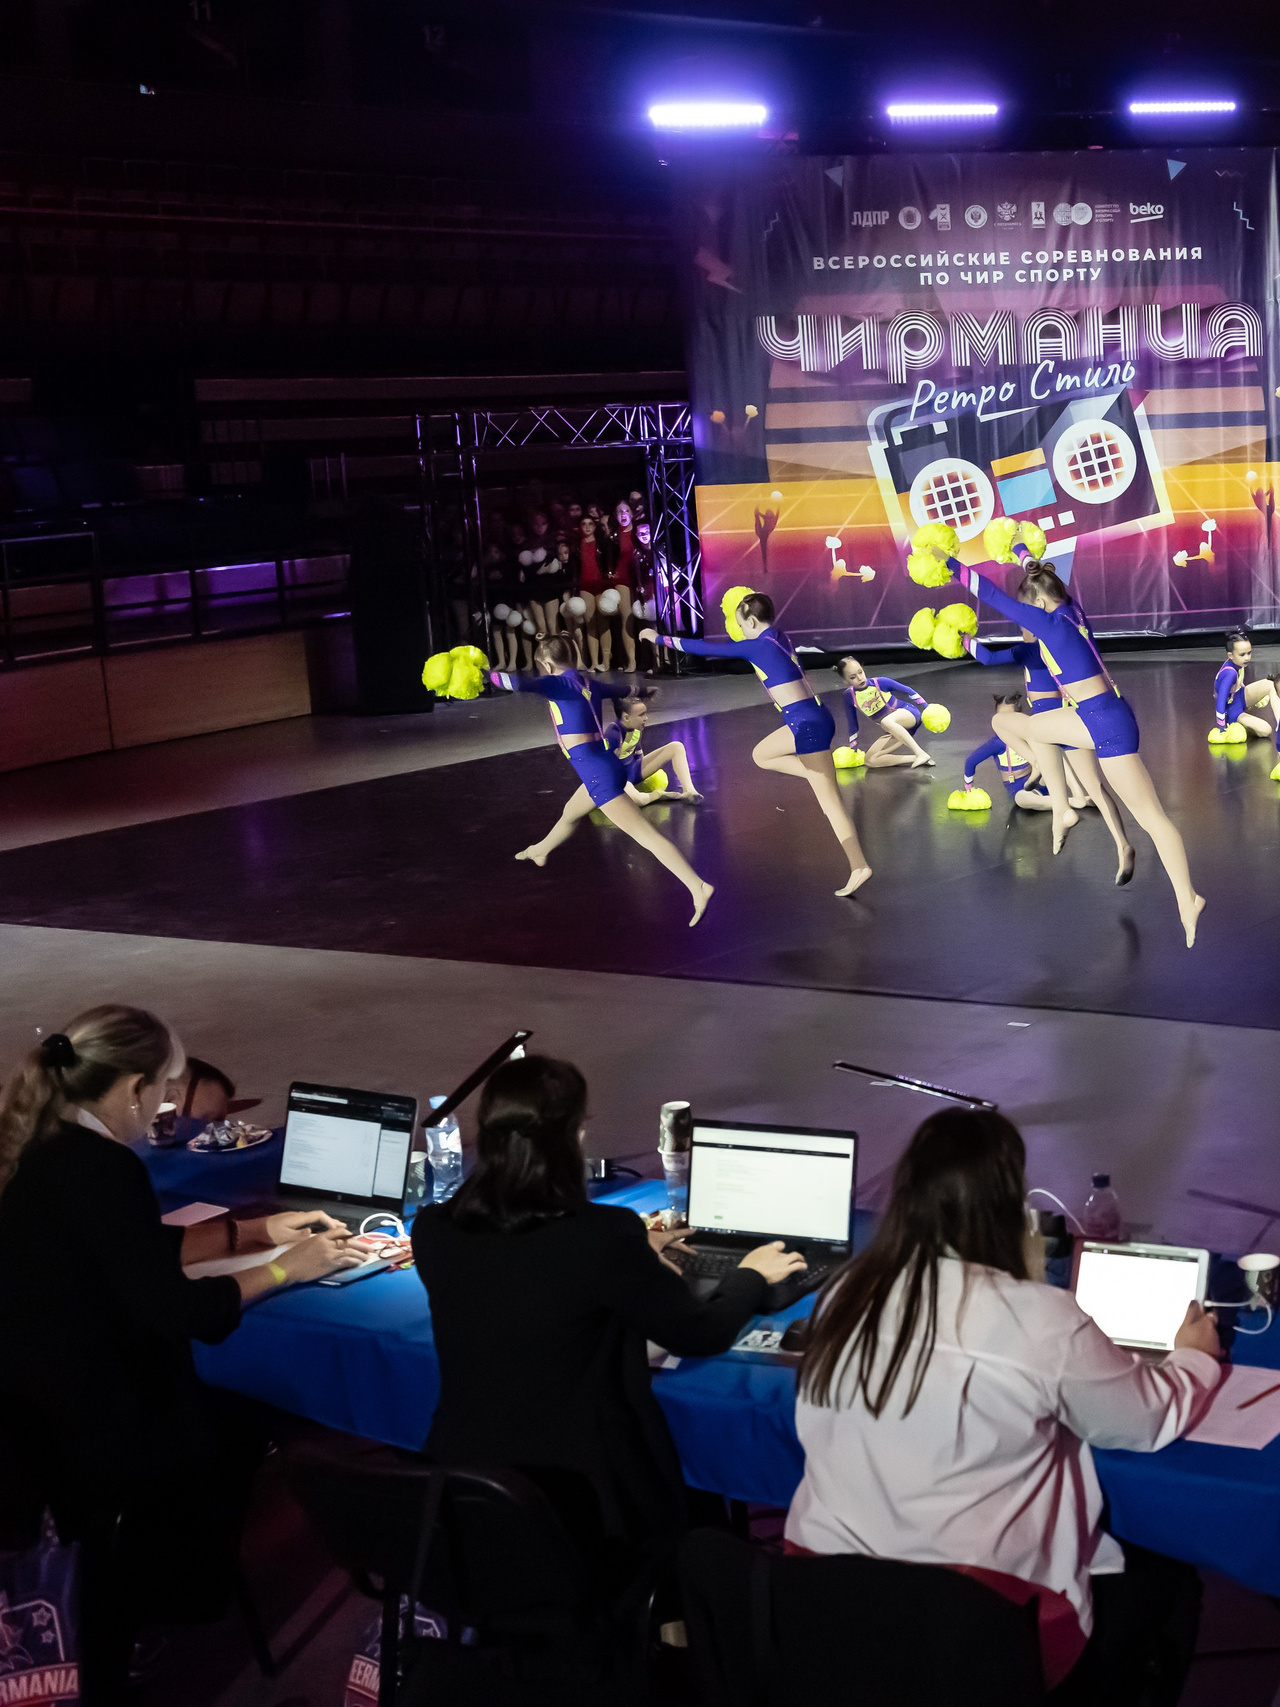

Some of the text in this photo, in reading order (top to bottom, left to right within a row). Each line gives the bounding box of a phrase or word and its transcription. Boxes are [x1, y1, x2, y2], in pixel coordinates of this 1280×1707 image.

[1129, 202, 1165, 216] beko
[851, 210, 890, 228] ЛДПР
[812, 246, 1204, 270] ВСЕРОССИЙСКИЕ СОРЕВНОВАНИЯ
[919, 267, 1102, 286] ПО ЧИР СПОРТУ
[910, 359, 1136, 421] Ретро Стиль
